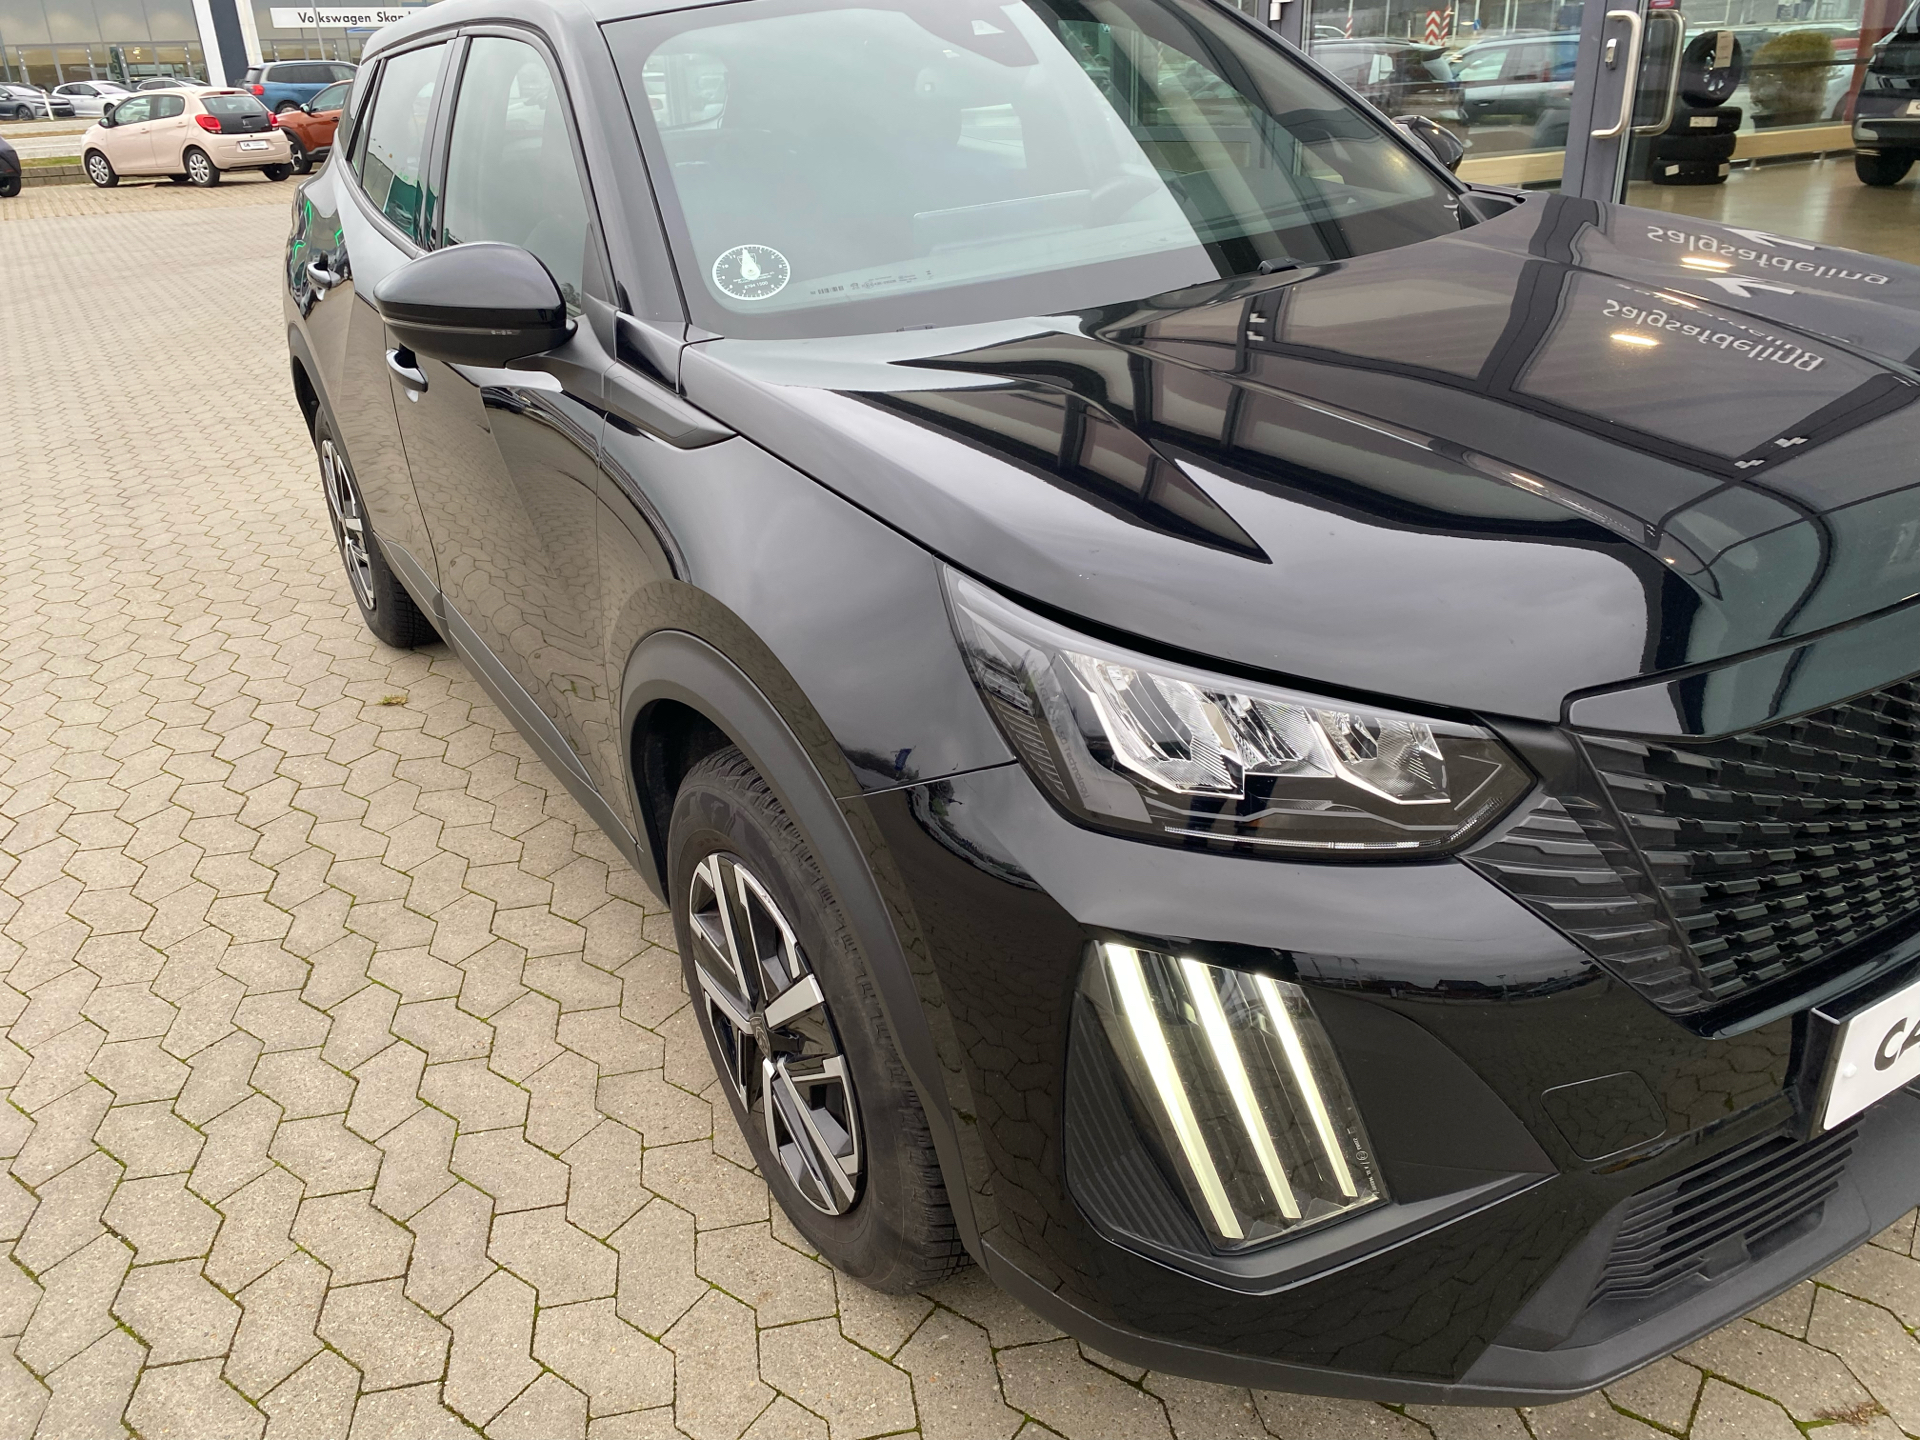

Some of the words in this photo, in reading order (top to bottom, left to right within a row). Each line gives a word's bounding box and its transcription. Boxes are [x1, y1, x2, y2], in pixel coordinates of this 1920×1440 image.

[298, 12, 371, 25] Vokswagen
[377, 11, 411, 23] Skan
[1064, 747, 1090, 799] Technology
